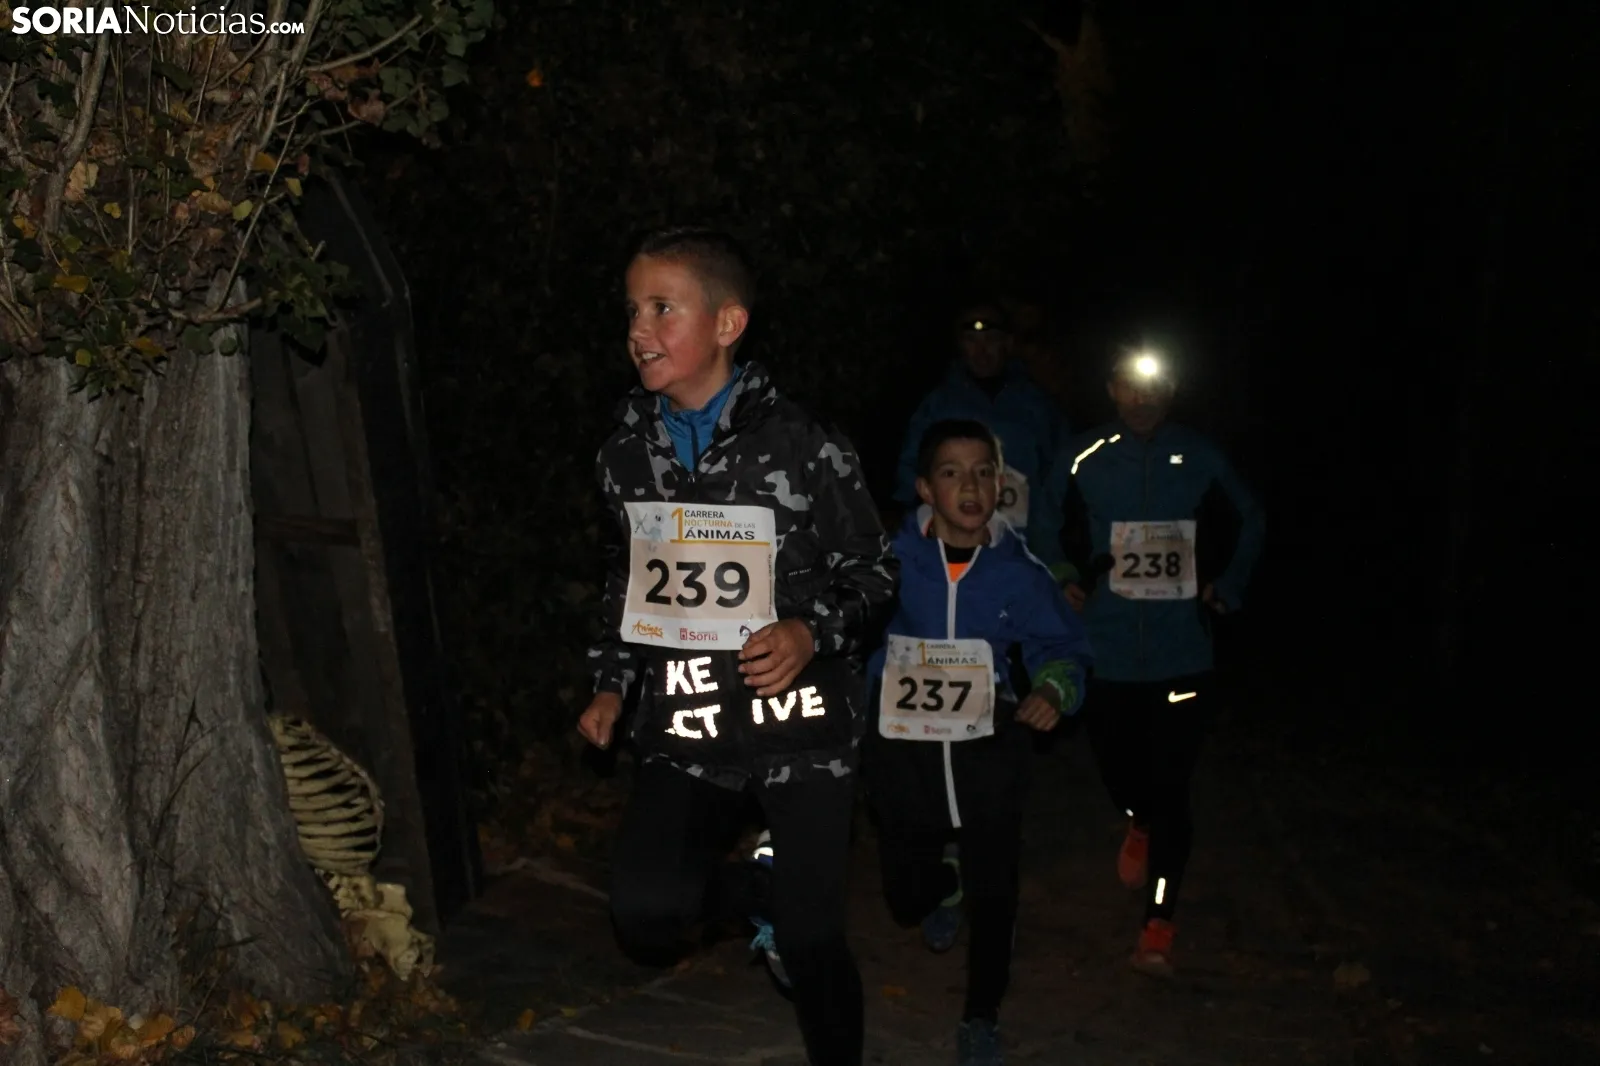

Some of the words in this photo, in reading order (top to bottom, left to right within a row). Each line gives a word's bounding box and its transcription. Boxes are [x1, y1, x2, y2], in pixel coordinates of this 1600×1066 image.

[684, 509, 725, 519] CARRERA
[684, 519, 733, 528] NOCTURNA
[684, 526, 756, 541] ÁNIMAS
[1121, 551, 1181, 579] 238
[645, 558, 750, 608] 239
[688, 631, 718, 642] Soria
[896, 675, 973, 712] 237
[665, 704, 721, 739] CT
